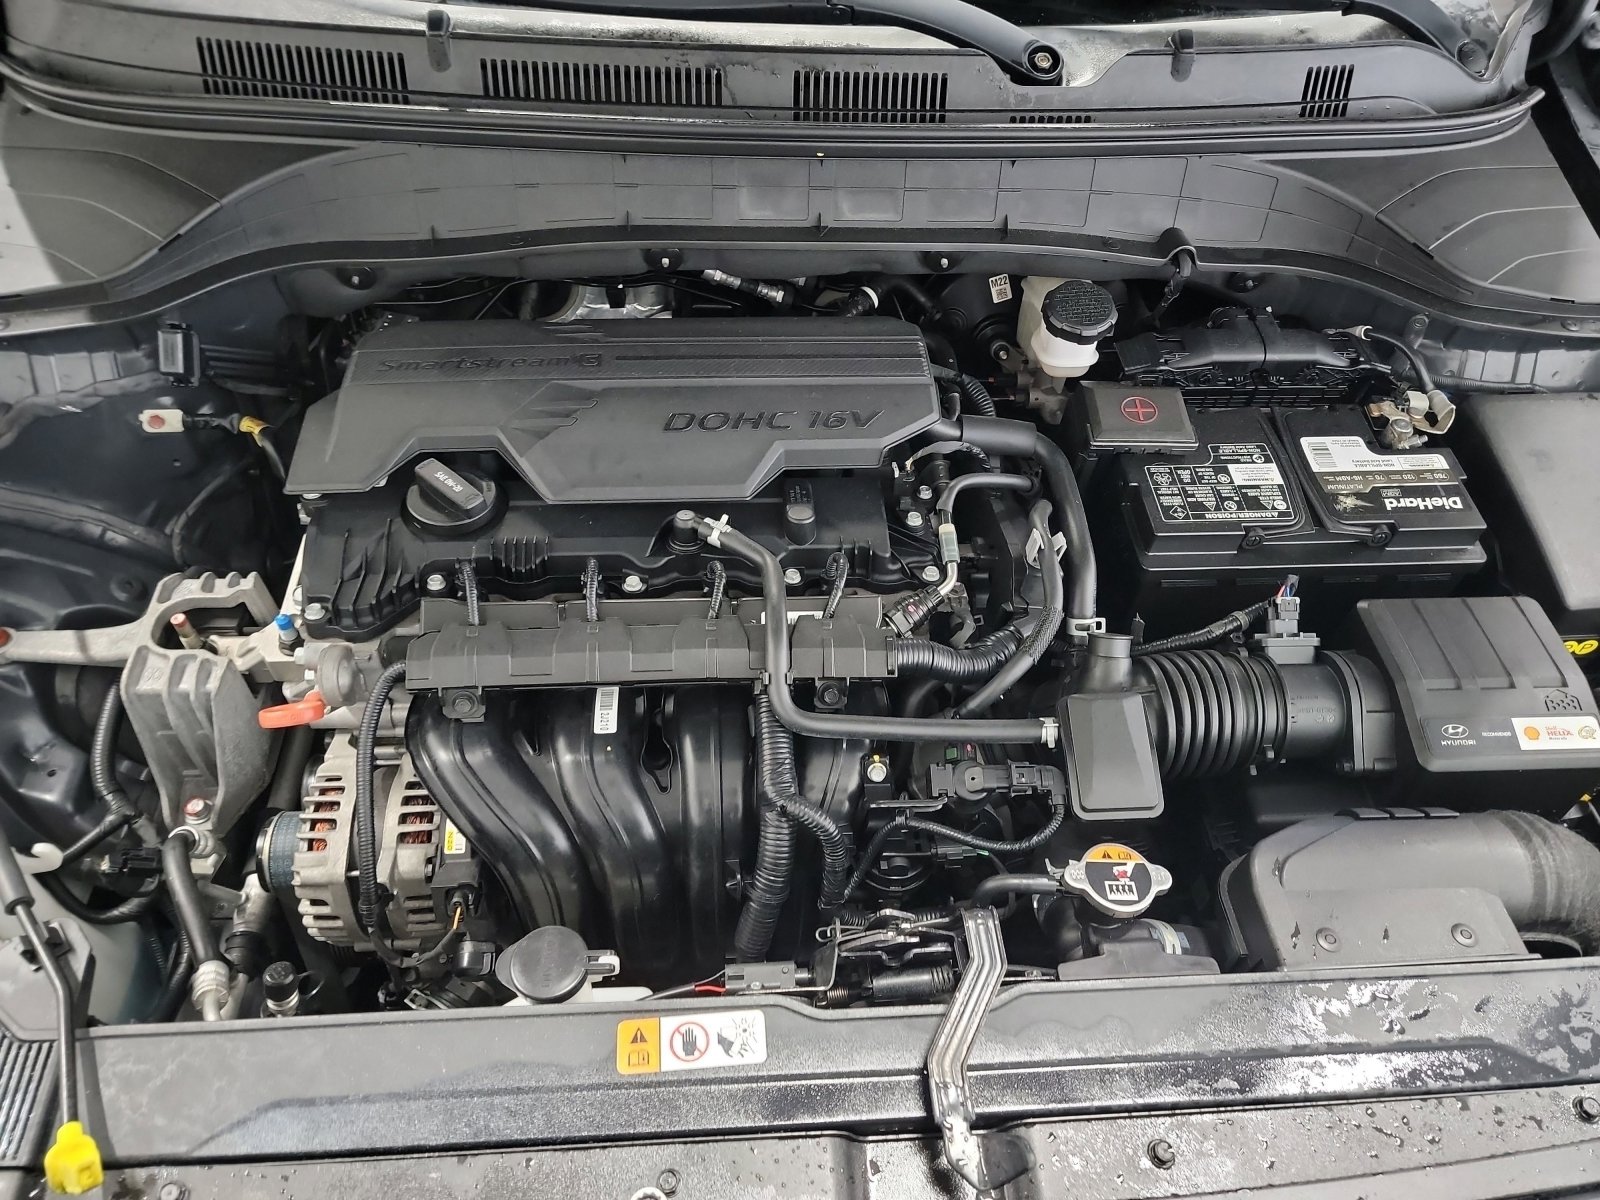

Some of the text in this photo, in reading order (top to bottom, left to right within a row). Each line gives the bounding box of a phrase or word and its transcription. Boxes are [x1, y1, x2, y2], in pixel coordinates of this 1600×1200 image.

[991, 276, 1008, 288] M22
[376, 355, 570, 372] Smartstream
[663, 409, 885, 432] DOHC 16V
[433, 471, 448, 482] SAE
[1384, 496, 1463, 510] DieHard
